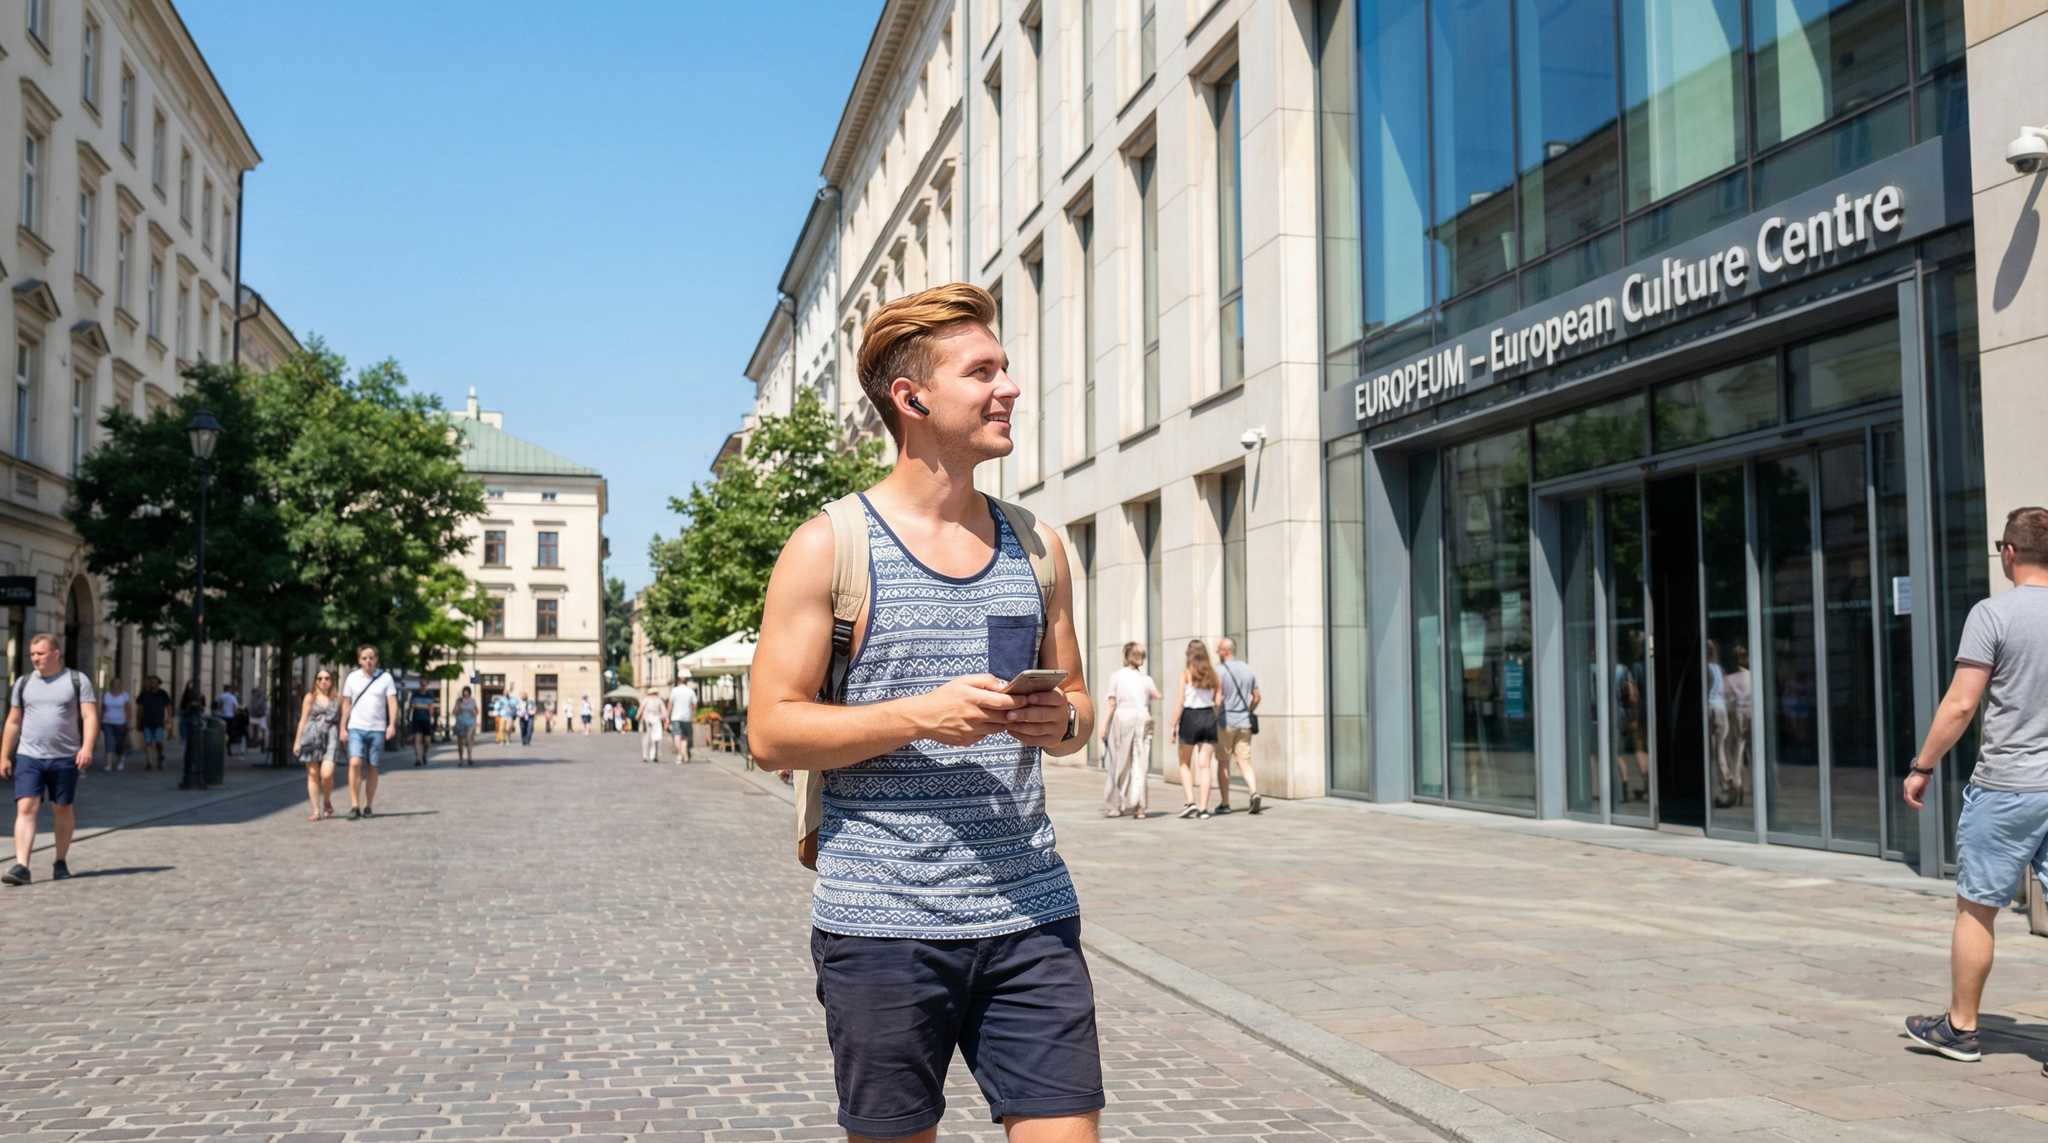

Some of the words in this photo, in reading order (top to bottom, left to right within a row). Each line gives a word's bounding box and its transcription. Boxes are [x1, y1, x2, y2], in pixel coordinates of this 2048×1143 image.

[1355, 345, 1465, 420] EUROPEUM
[1491, 296, 1613, 373] European
[1622, 245, 1748, 323] Culture
[1757, 184, 1902, 273] Centre
